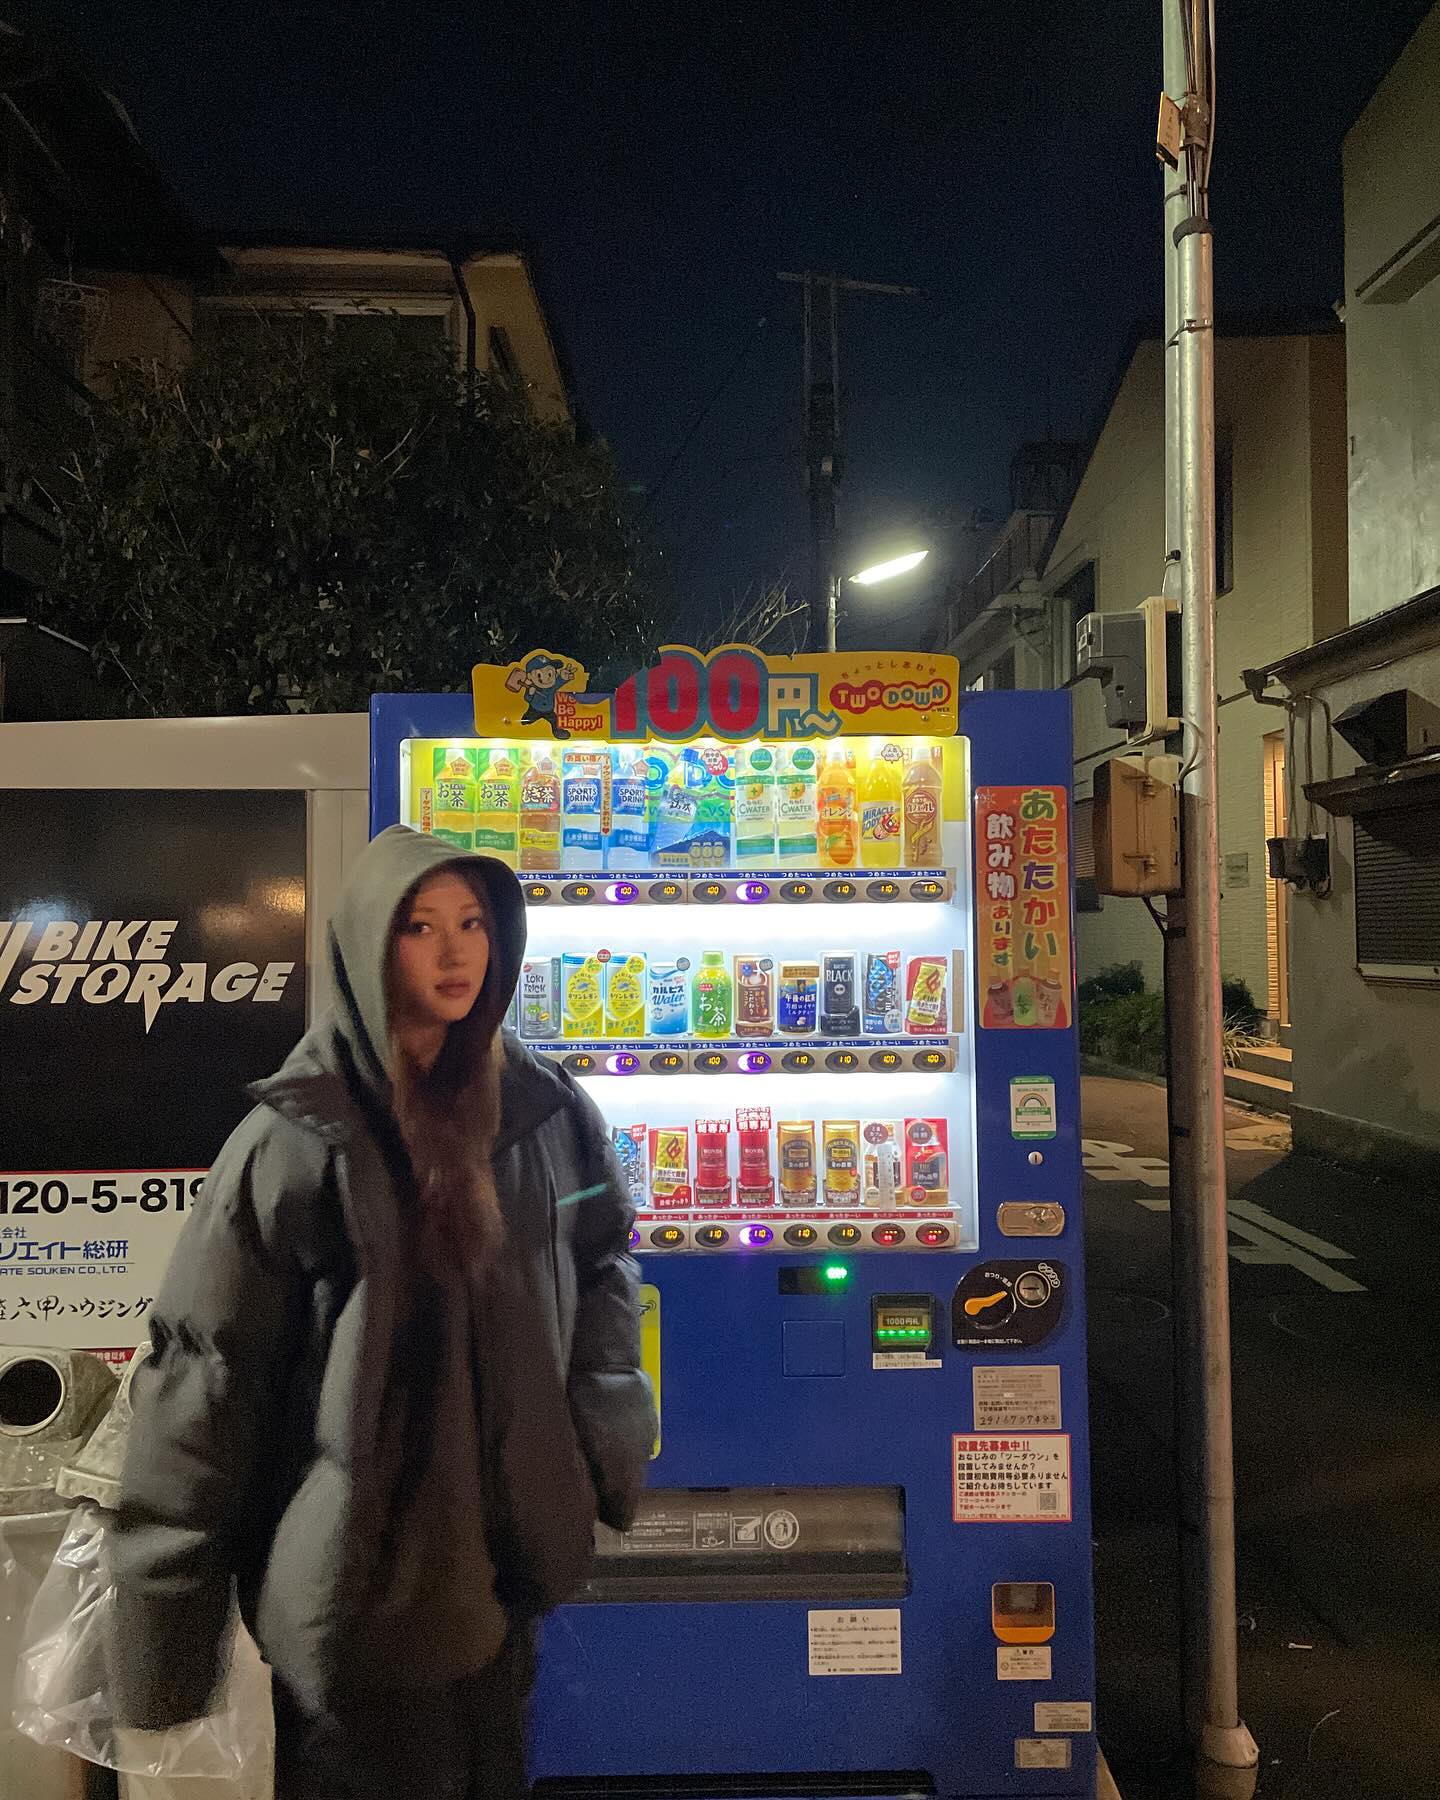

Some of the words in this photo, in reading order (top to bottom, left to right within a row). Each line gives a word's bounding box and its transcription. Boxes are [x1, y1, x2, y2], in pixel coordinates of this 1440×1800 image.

[841, 660, 937, 679] ちょっとしあわせ
[556, 692, 577, 703] We
[837, 685, 882, 709] TWO
[886, 685, 945, 707] DOWN
[556, 704, 576, 716] Be
[557, 716, 603, 729] Happy!
[1021, 790, 1057, 962] あたたかい
[532, 888, 544, 896] 100
[576, 887, 588, 896] 100
[620, 887, 632, 895] 100
[664, 887, 676, 895] 100
[707, 886, 719, 895] 100
[750, 886, 763, 894] 110
[794, 886, 806, 894] 110
[837, 885, 850, 894] 110
[881, 885, 893, 893] 110
[924, 885, 936, 893] 110
[32, 920, 179, 961] BIKE
[826, 969, 853, 983] BLACK
[9, 962, 295, 1034] STORAGE
[577, 1058, 589, 1067] 110
[621, 1058, 633, 1066] 110
[665, 1057, 677, 1065] 110
[709, 1057, 720, 1065] 100
[752, 1056, 764, 1064] 110
[796, 1056, 808, 1064] 110
[883, 1055, 895, 1063] 100
[927, 1055, 939, 1063] 100
[666, 1230, 678, 1239] 100
[710, 1230, 722, 1238] 110
[754, 1229, 766, 1237] 110
[798, 1229, 810, 1237] 110
[842, 1229, 854, 1237] 110
[27, 1266, 75, 1275] SOUKEN
[11, 1295, 153, 1322] 六甲ハウジング
